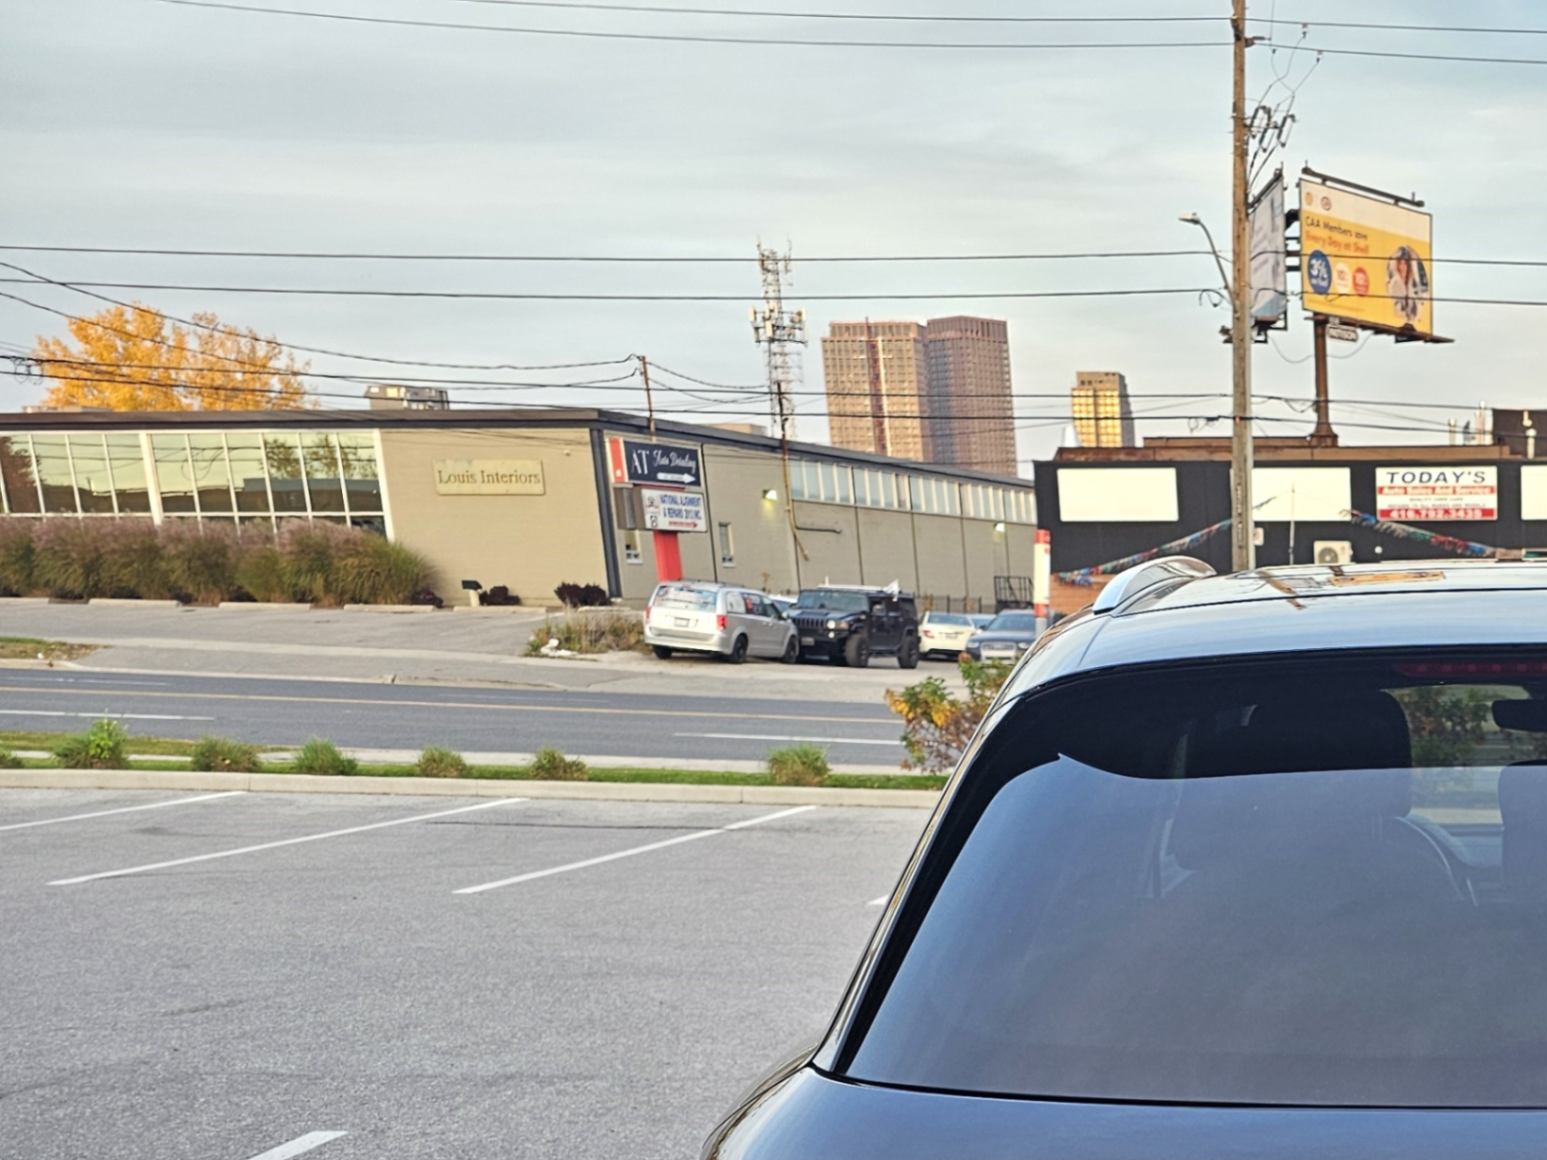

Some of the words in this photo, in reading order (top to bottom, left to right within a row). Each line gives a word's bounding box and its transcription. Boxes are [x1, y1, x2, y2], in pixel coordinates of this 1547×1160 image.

[631, 448, 649, 475] AT
[438, 470, 477, 484] Louis
[480, 469, 540, 484] Interiors
[1386, 471, 1486, 484] TODAY'S
